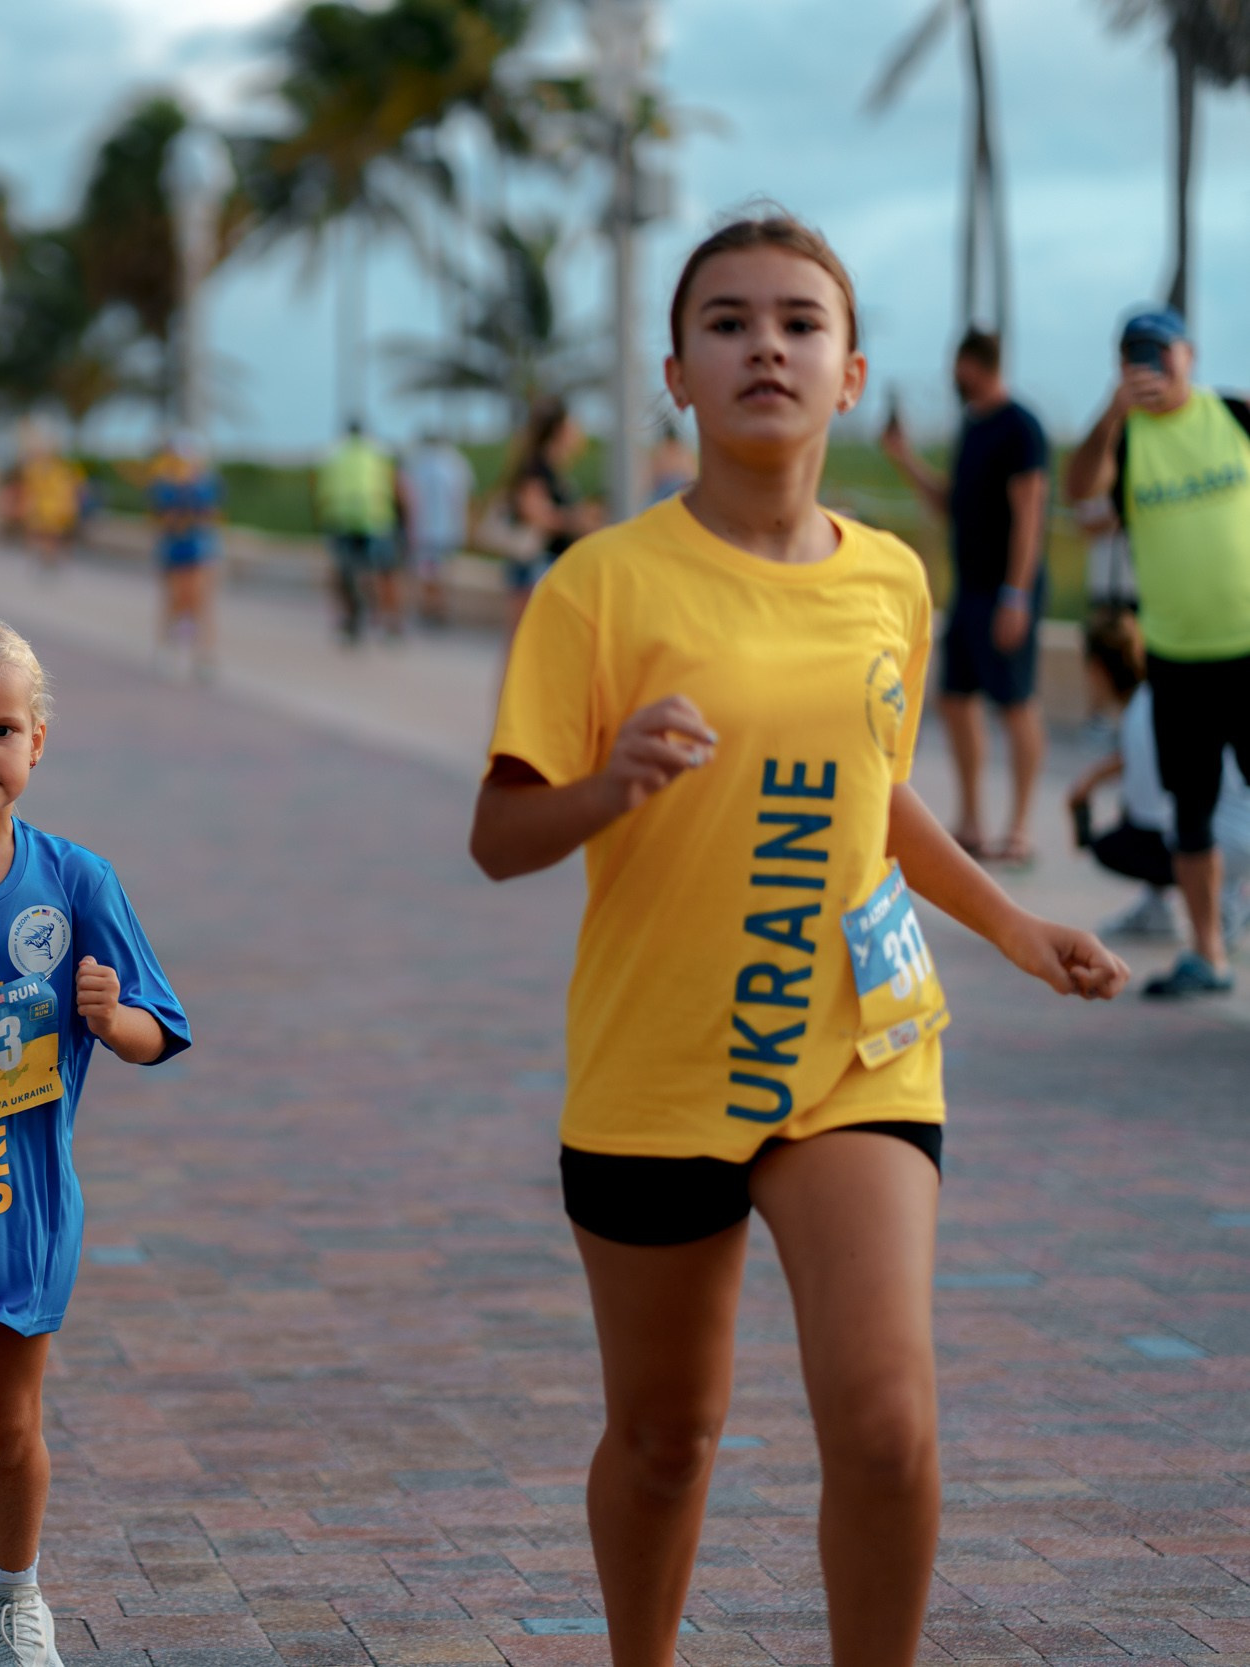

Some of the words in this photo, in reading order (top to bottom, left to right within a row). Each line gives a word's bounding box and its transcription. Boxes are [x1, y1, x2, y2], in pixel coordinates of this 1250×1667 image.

[14, 914, 31, 936] RAZOM
[52, 912, 63, 924] RUN
[726, 758, 837, 1124] UKRAINE
[8, 982, 39, 1003] RUN
[34, 1002, 49, 1011] KIDS
[10, 1083, 54, 1106] UKRAINI!
